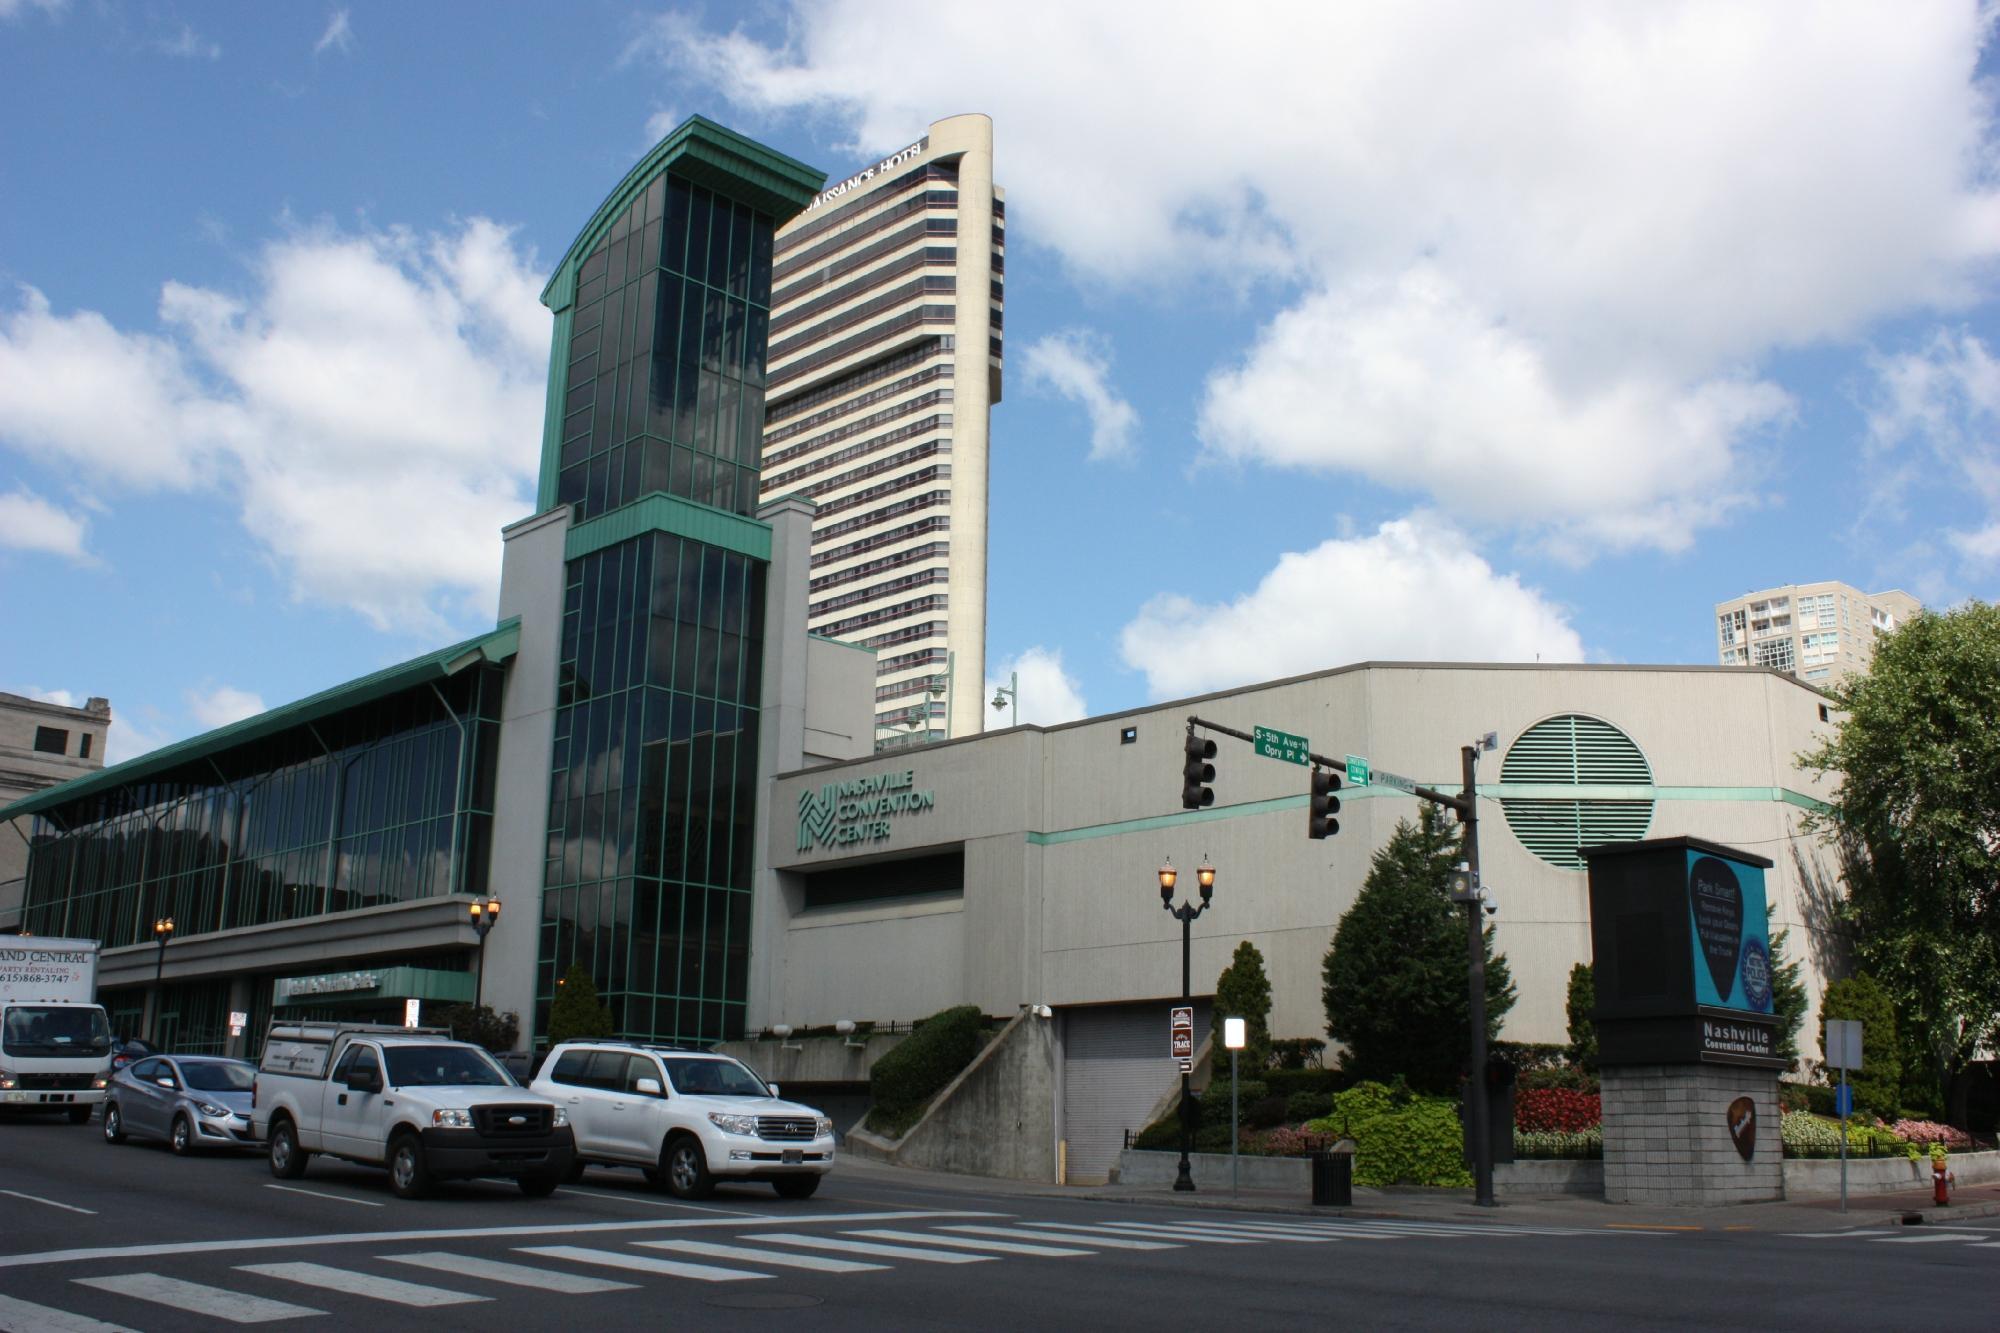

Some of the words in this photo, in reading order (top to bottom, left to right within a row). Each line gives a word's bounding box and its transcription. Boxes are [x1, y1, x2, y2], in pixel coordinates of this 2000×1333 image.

[880, 142, 921, 174] HOTEL
[1265, 744, 1282, 758] Opry
[1286, 749, 1295, 760] Pl
[838, 769, 912, 798] NASHVILLE
[839, 790, 935, 821] CONVENTION
[837, 820, 890, 843] CENTER
[30, 952, 88, 963] CENTRAL
[1704, 1022, 1769, 1043] Nashville
[1705, 1038, 1745, 1052] Convention
[1746, 1043, 1769, 1054] Center
